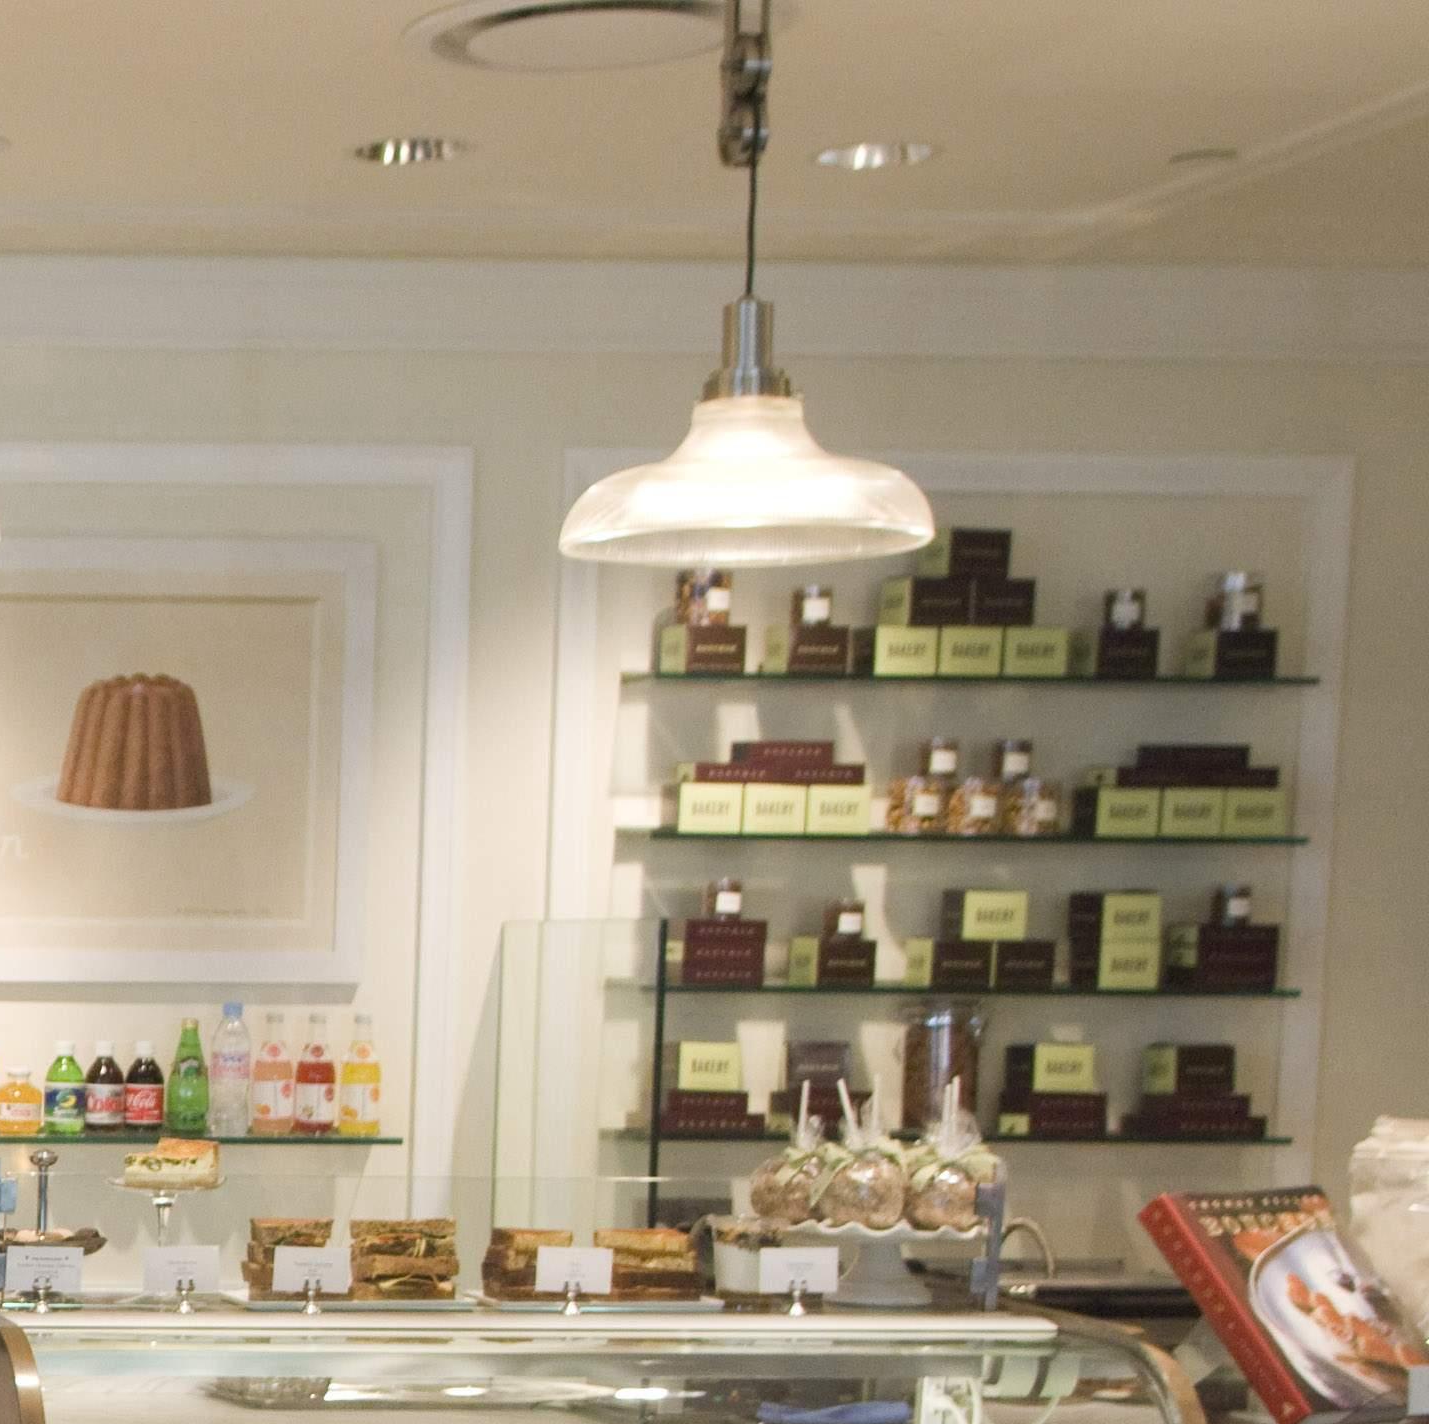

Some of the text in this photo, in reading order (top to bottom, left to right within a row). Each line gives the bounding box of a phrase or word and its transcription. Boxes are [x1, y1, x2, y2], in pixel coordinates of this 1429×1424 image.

[691, 801, 730, 816] BAKERY
[755, 801, 794, 816] BAKERY
[819, 801, 860, 816] BAKERY
[691, 1058, 730, 1074] BAKERY
